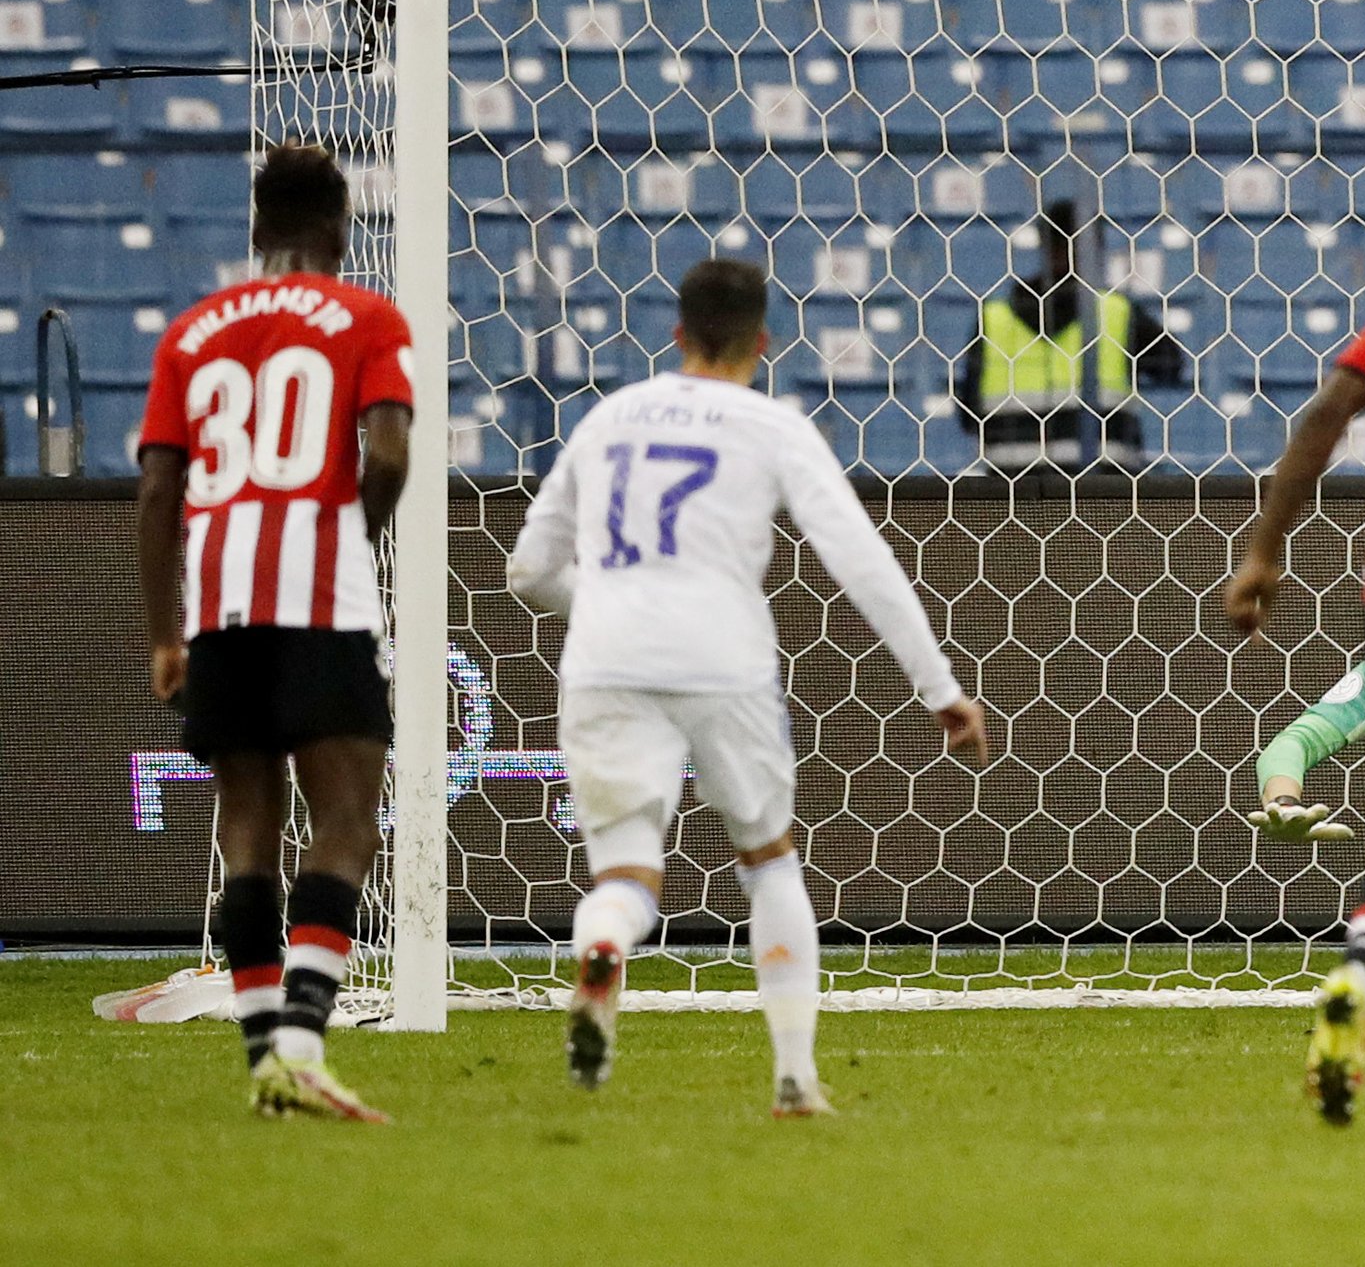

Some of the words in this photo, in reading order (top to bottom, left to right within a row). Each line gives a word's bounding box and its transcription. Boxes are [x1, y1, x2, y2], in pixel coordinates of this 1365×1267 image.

[177, 285, 325, 355] WILLIAMS
[185, 344, 336, 509] 30
[613, 400, 694, 428] LUCAS
[600, 442, 720, 570] 17
